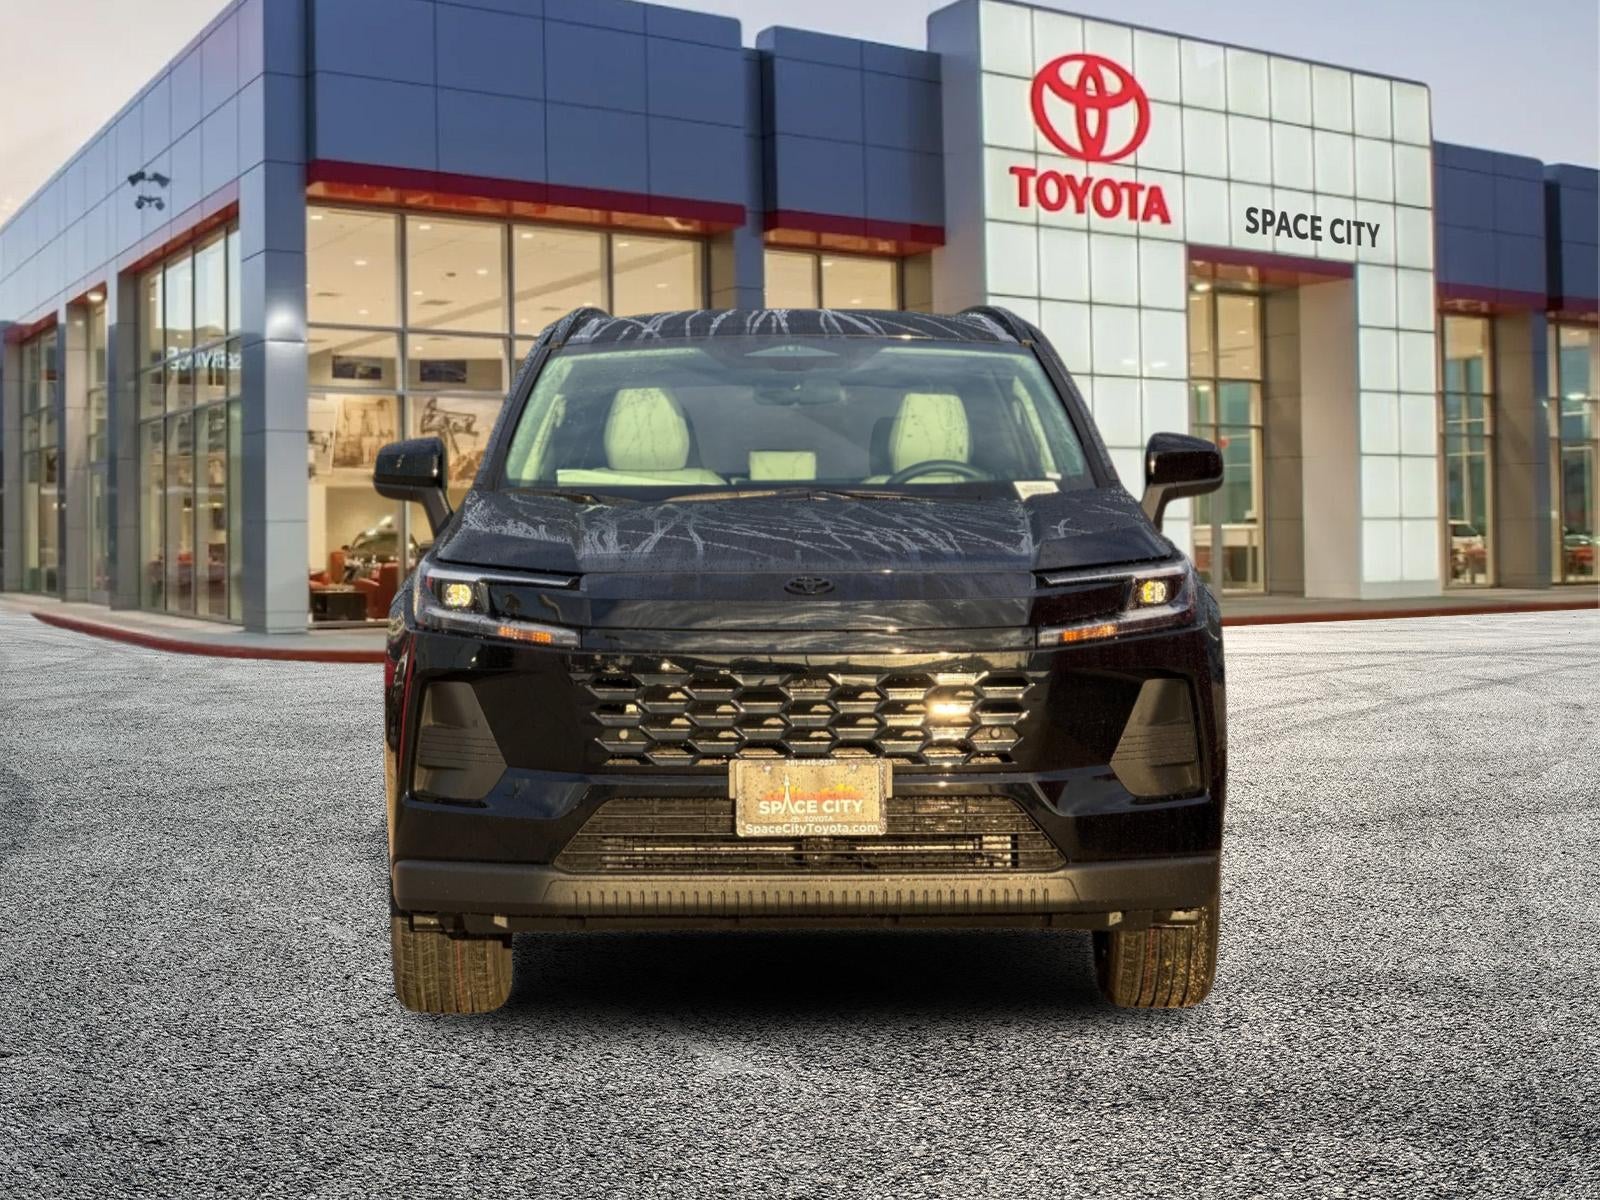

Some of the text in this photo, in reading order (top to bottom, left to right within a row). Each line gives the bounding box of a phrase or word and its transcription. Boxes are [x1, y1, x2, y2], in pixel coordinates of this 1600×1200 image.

[1009, 166, 1172, 225] TOYOTA
[1245, 207, 1381, 248] SPACE CITY
[758, 799, 864, 815] SPACE CITY
[745, 823, 879, 836] SpaceCityToyota.com
